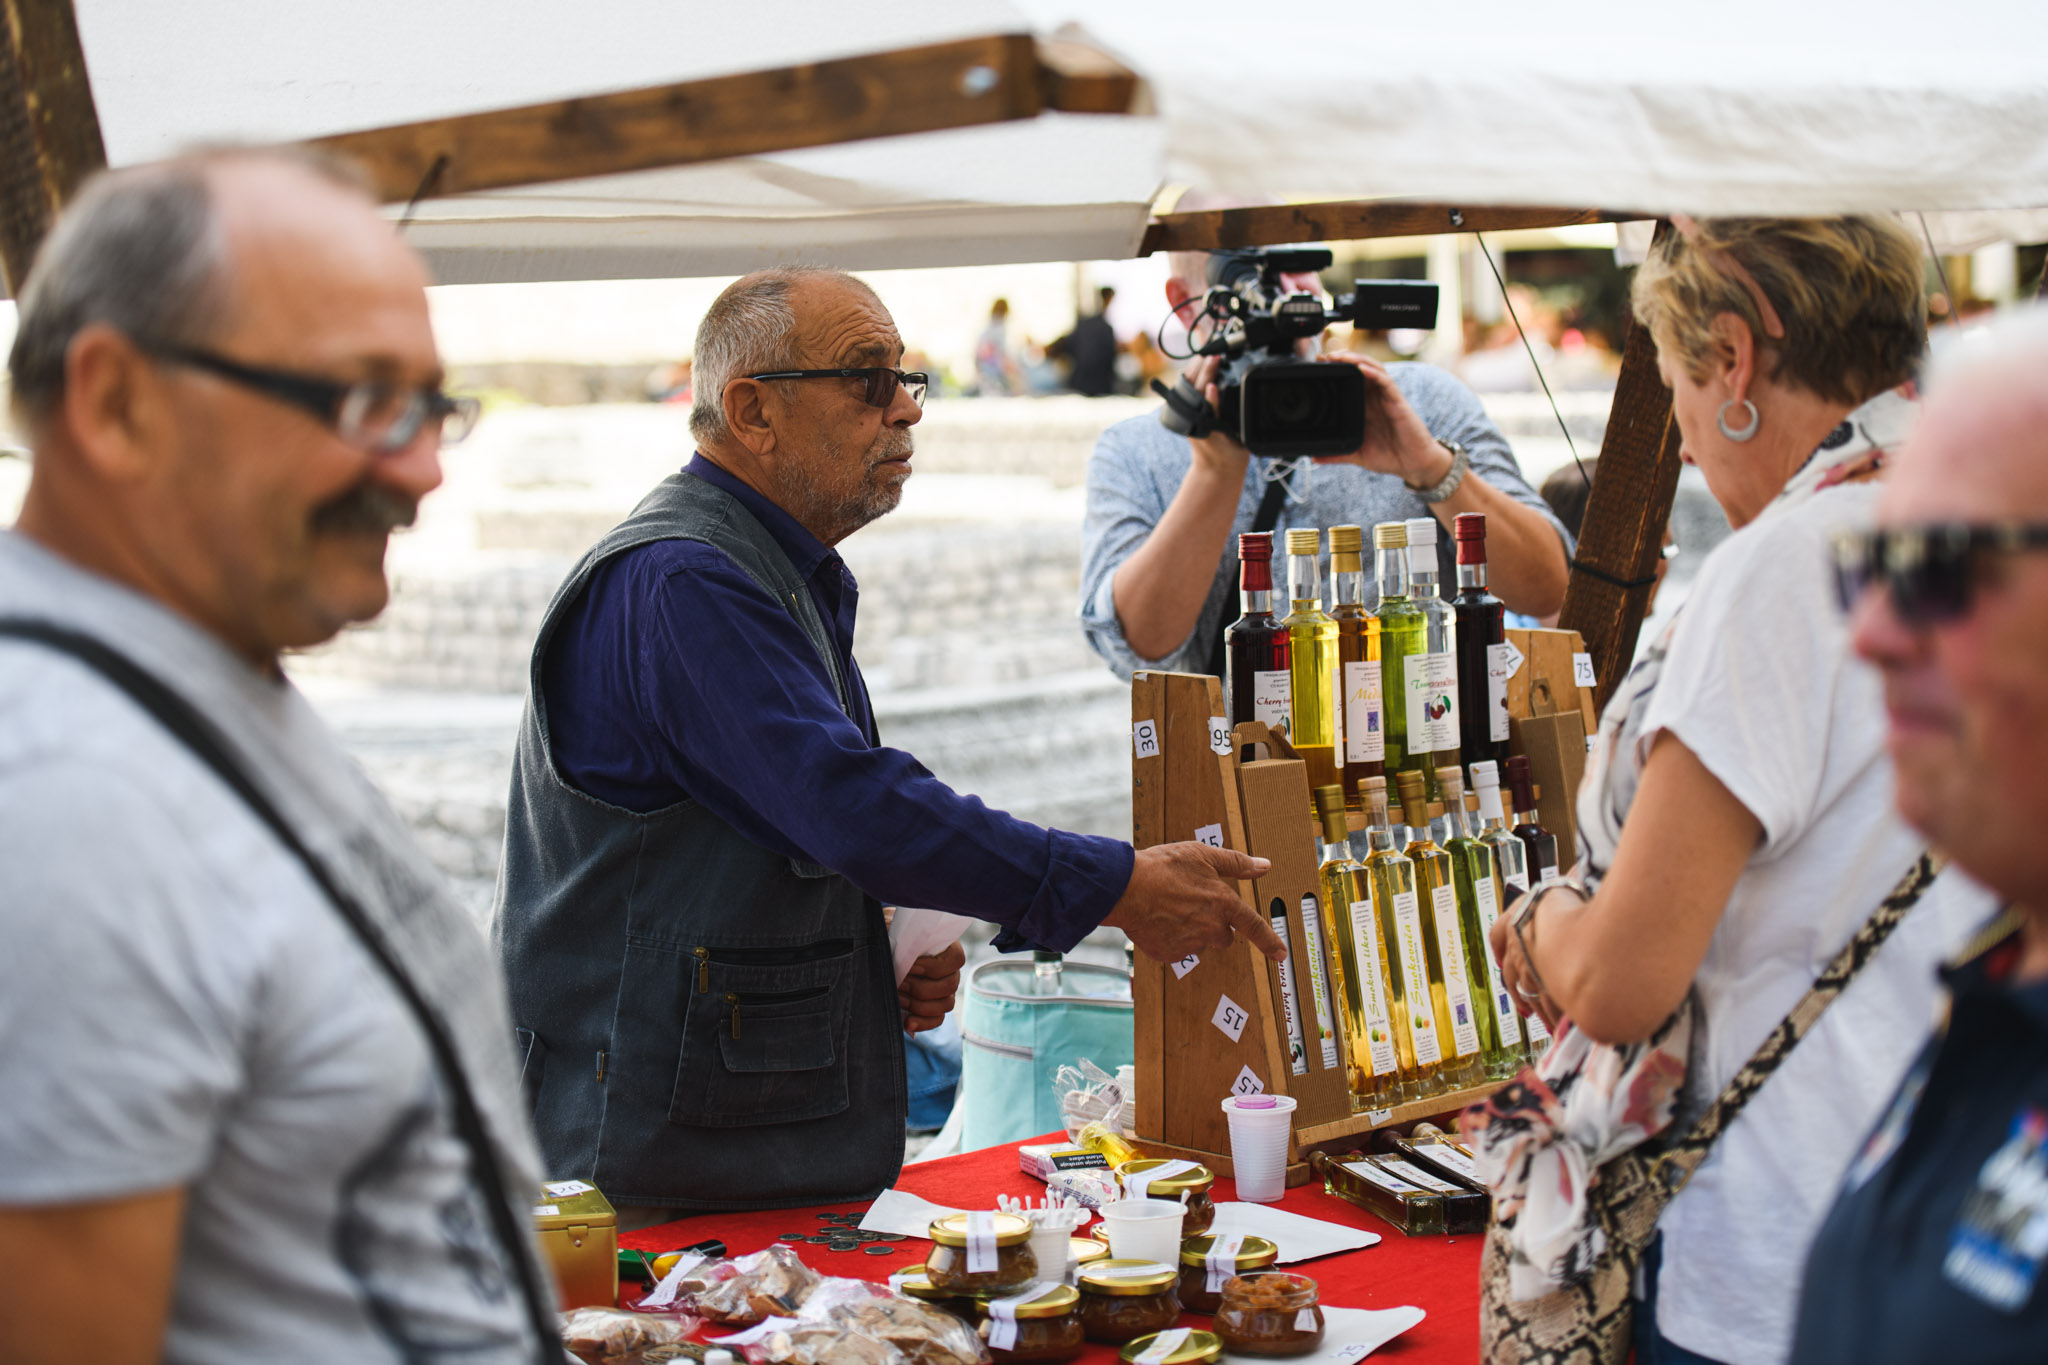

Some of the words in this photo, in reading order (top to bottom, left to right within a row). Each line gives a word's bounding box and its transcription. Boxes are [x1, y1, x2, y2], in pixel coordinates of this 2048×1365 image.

[1576, 662, 1592, 680] 75
[1256, 696, 1282, 707] Cherry
[1138, 725, 1155, 752] 30
[1213, 729, 1233, 748] 95
[1363, 928, 1372, 959] liker
[1446, 929, 1463, 984] Medica
[1305, 931, 1327, 1017] Smokovača
[1403, 924, 1424, 1008] Smokovača
[1222, 1006, 1244, 1031] 15
[1282, 991, 1294, 1036] Cherry
[1238, 1075, 1260, 1095] 15
[1059, 1160, 1085, 1168] uzrokuje
